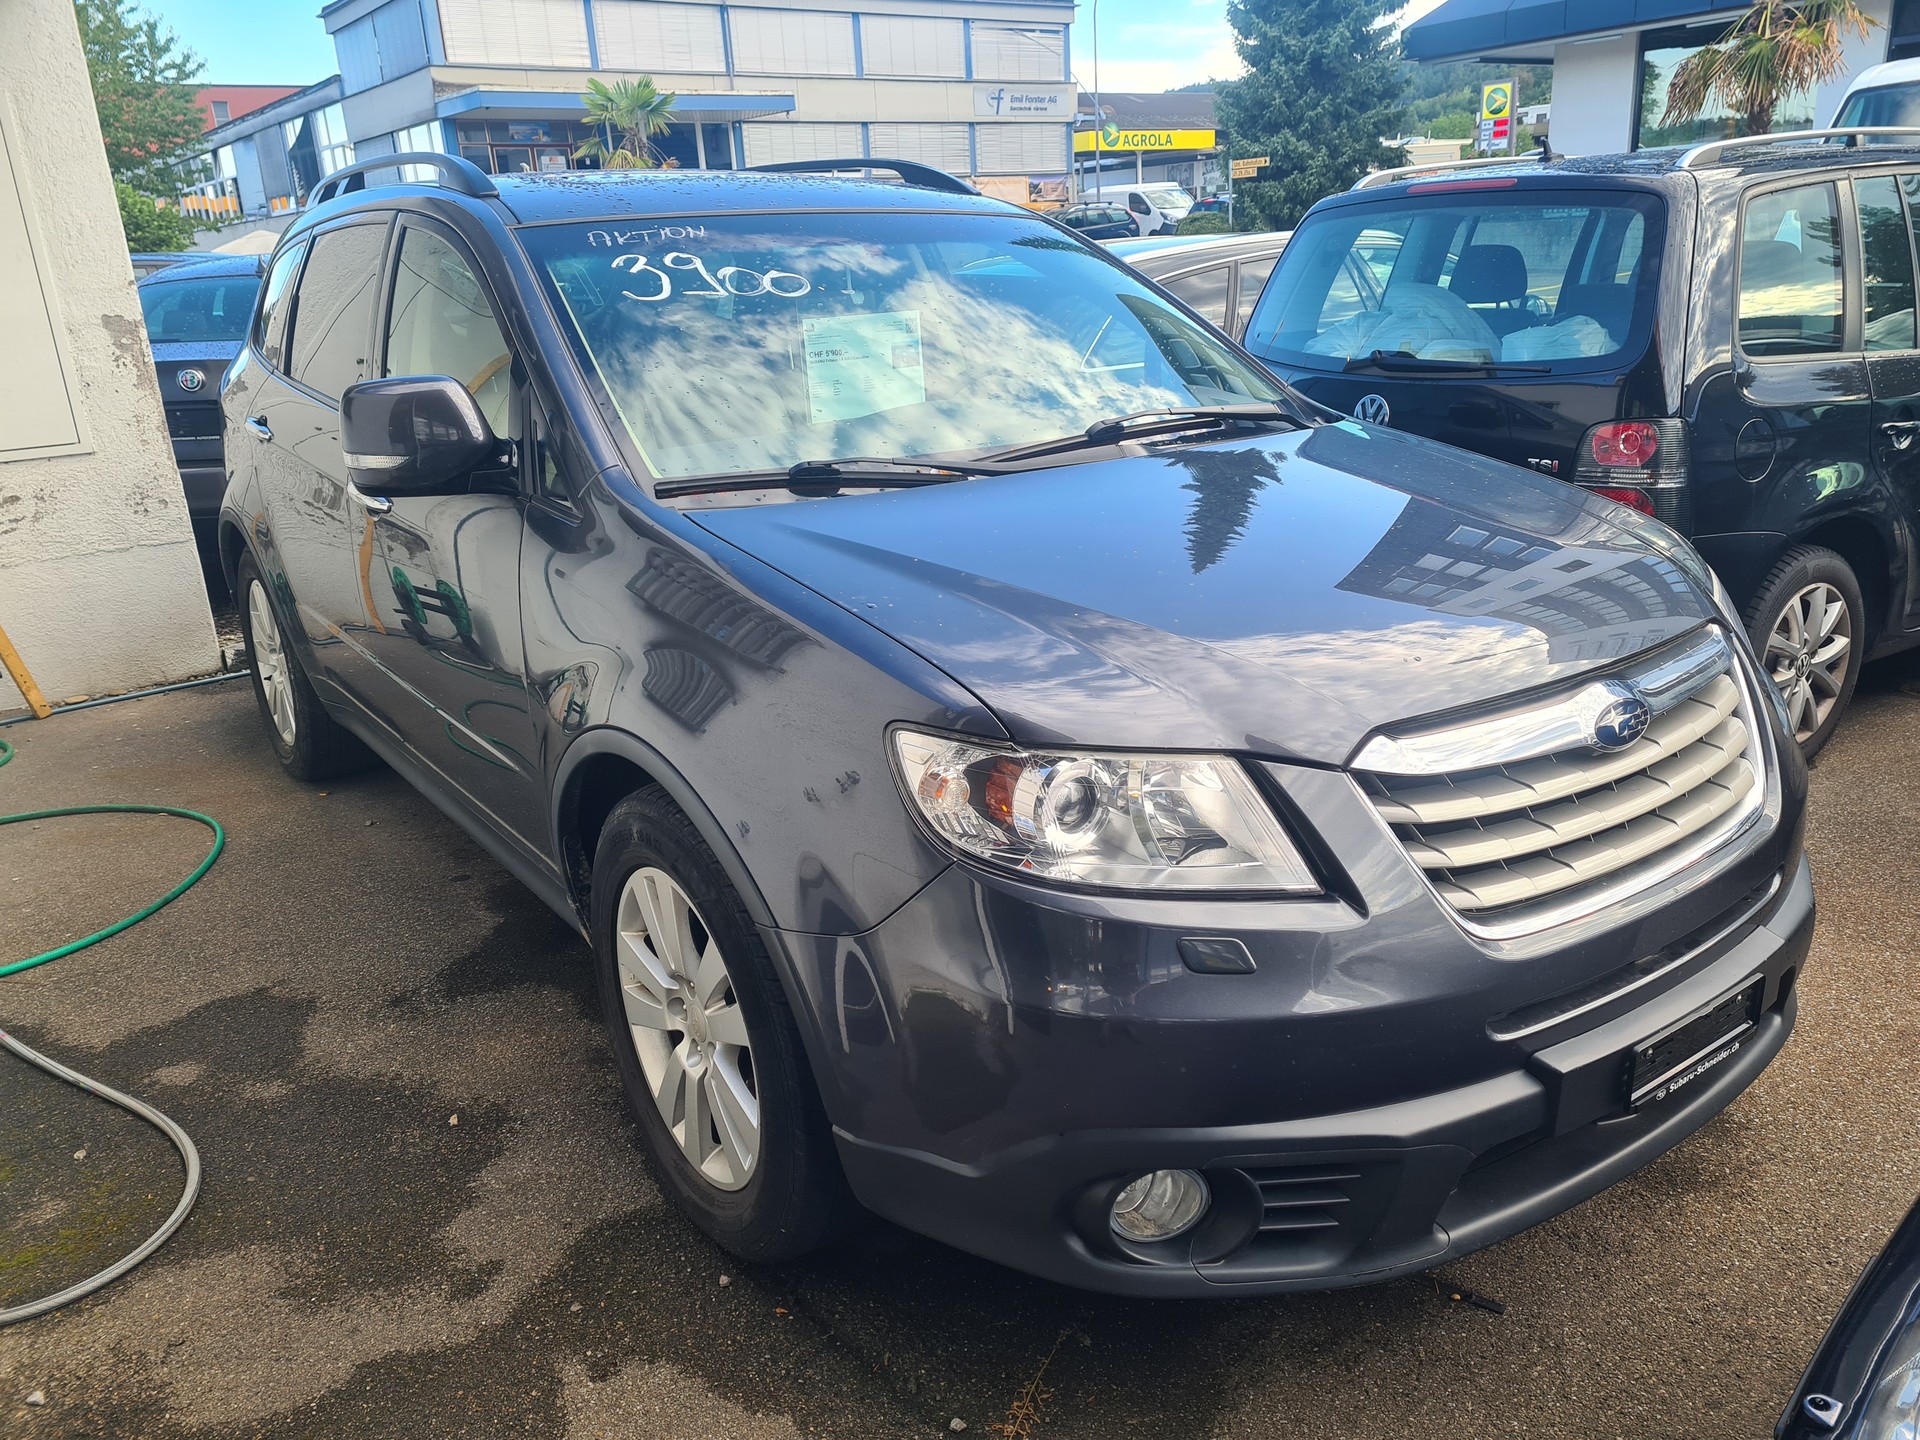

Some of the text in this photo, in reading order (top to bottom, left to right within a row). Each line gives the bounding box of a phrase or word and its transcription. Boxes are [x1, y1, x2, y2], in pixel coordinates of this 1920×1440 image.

[1010, 95, 1057, 104] Emil Forster AG
[1122, 133, 1173, 147] AGROLA
[587, 225, 705, 247] AKTION
[611, 251, 811, 301] 3900
[809, 351, 823, 359] CHF
[1669, 1042, 1740, 1093] Subaru-Schneider.ch
